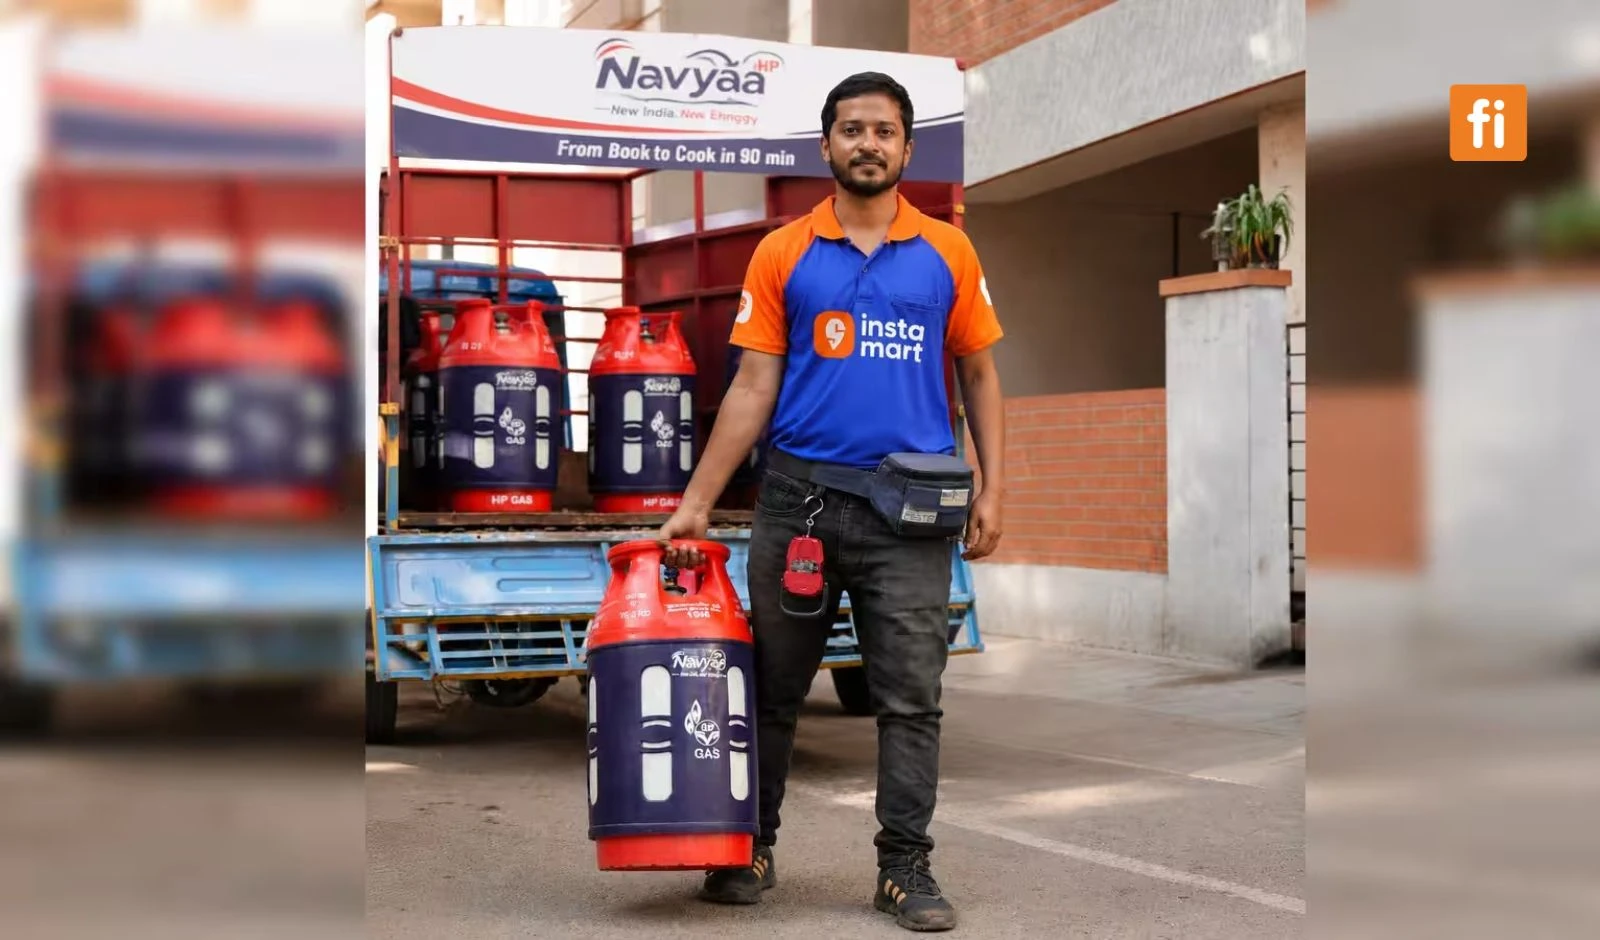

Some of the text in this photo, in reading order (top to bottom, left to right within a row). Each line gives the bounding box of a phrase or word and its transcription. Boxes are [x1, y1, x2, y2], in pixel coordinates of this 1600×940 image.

[610, 105, 639, 117] New
[557, 139, 796, 167] From Book to Cook in 90 min
[860, 312, 925, 343] insta
[860, 340, 924, 364] mart
[491, 495, 533, 505] HP GAS
[694, 748, 721, 759] GAS
